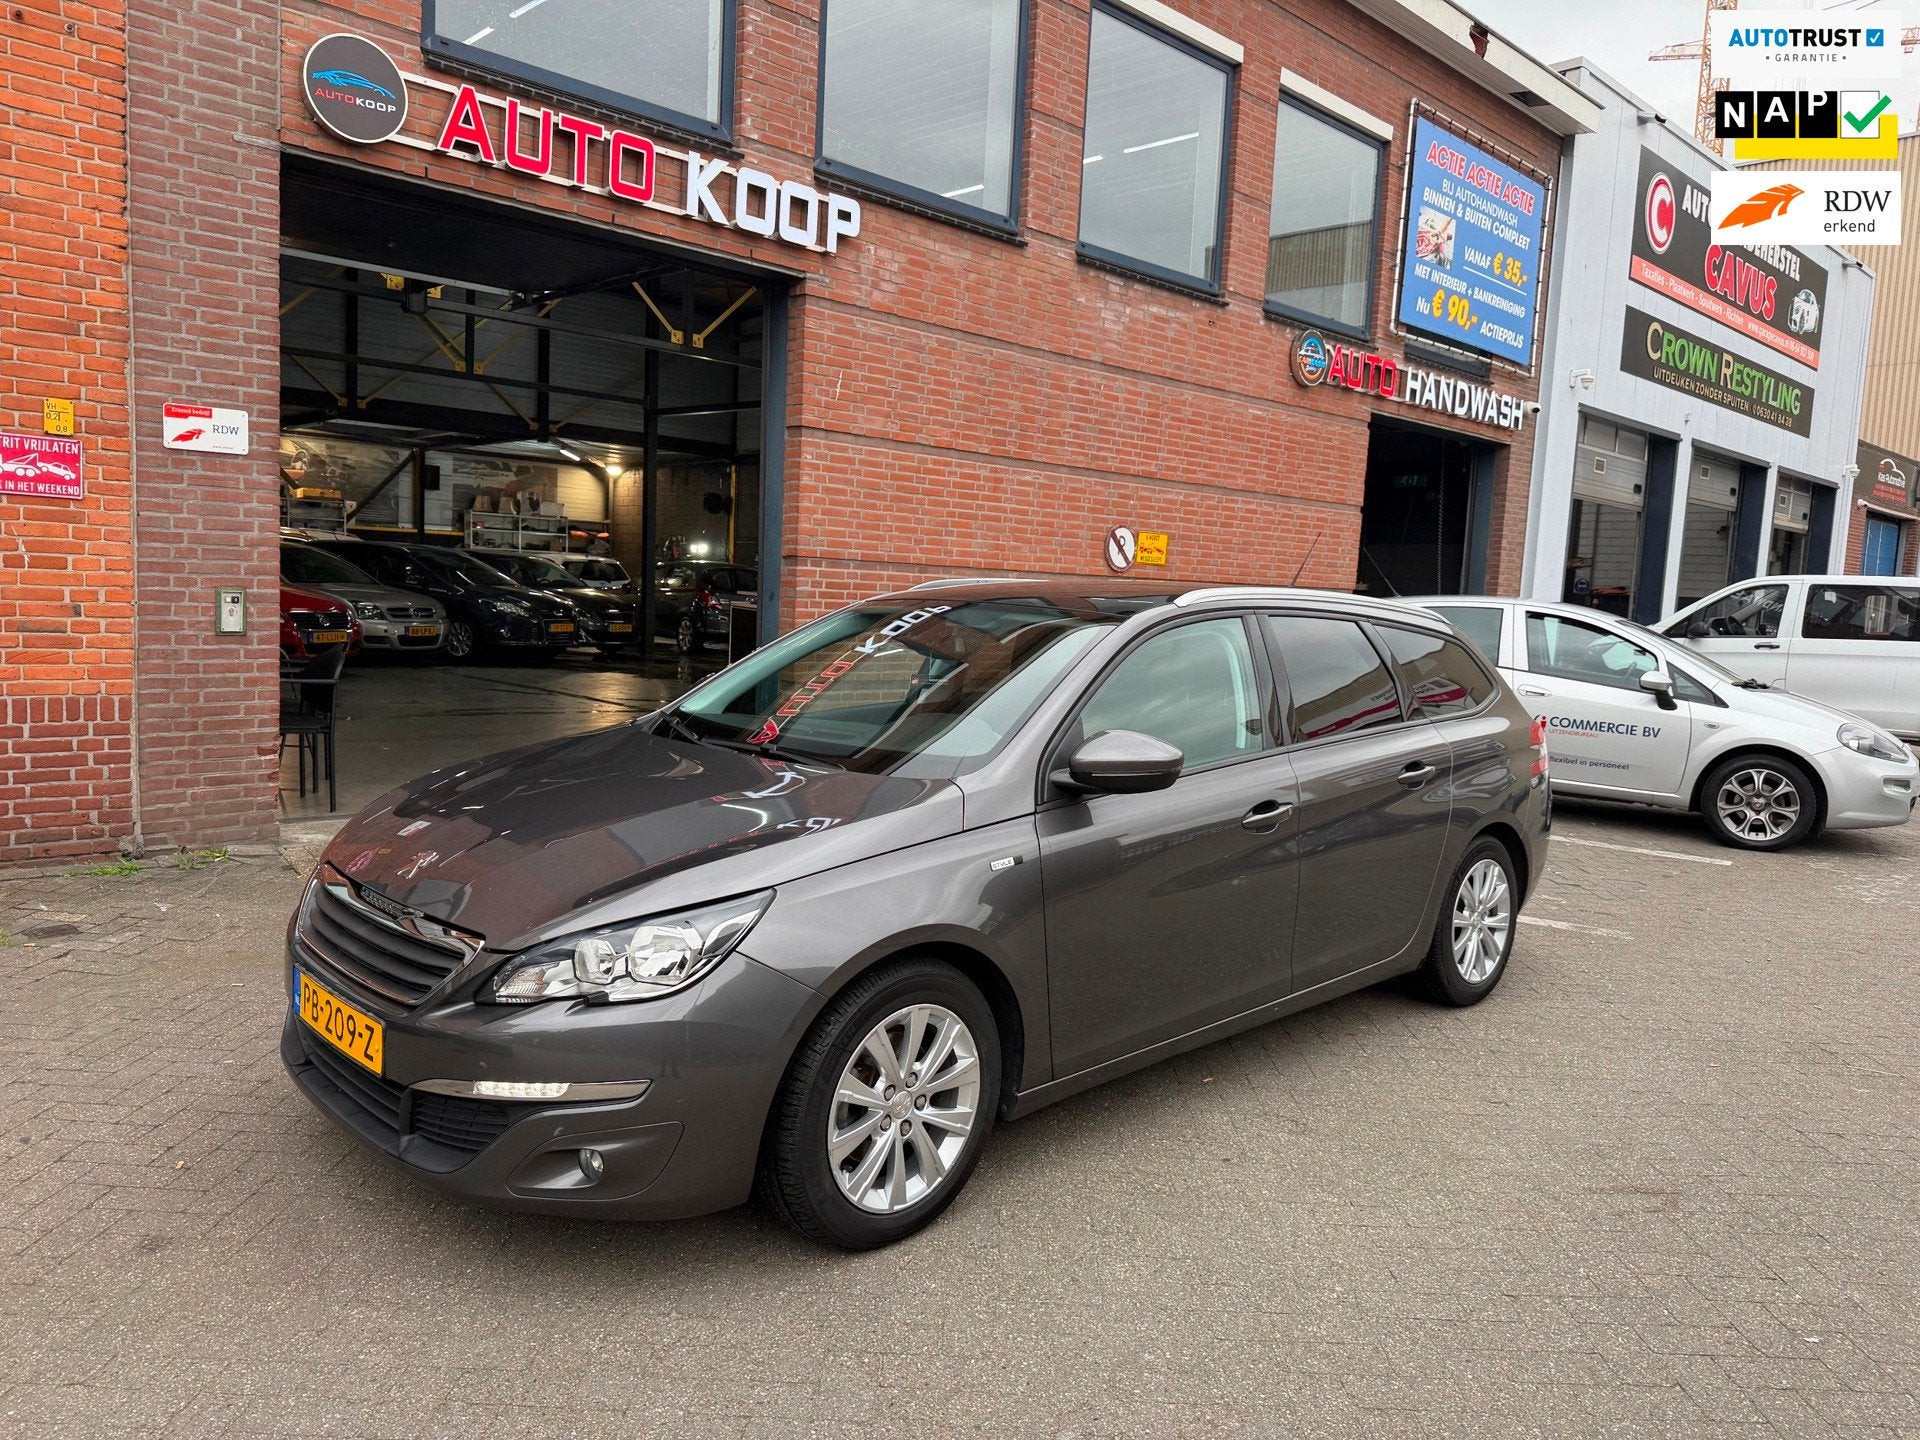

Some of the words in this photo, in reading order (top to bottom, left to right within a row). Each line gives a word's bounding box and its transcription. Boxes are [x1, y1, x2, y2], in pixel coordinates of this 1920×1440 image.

[315, 88, 396, 113] AUTOKOOP
[437, 85, 655, 202] AUTO
[686, 150, 861, 254] KOOP
[1427, 141, 1466, 179] ACTIE
[1466, 160, 1502, 198] ACTIE
[1501, 179, 1535, 216] ACTIE
[1423, 187, 1455, 213] BINNEN
[1457, 203, 1464, 218] &
[1464, 209, 1492, 232] BUITEN
[1492, 222, 1531, 251] COMPLEET
[1443, 178, 1455, 194] BIJ
[1455, 184, 1518, 228] AUTOHANDWASH
[1464, 246, 1492, 269] VANAF
[1493, 252, 1504, 275] €
[1704, 244, 1778, 321] CAVUS
[1415, 263, 1431, 280] MET
[1431, 269, 1467, 296] INTERIEUR
[1473, 287, 1526, 319] BANKREINIGING
[1416, 296, 1430, 316] Nu
[1432, 289, 1446, 319] €
[1480, 320, 1524, 349] ACTIEPRIJS
[1327, 344, 1397, 398] AUTO
[1404, 366, 1524, 431] HANDWASH
[1646, 322, 1719, 383] CROWN
[1720, 351, 1802, 416] RESTYLING
[1653, 366, 1695, 391] UITDEUKEN
[1695, 382, 1723, 402] ZONDER
[1723, 393, 1750, 412] SPUITEN
[212, 424, 240, 436] RDW
[5, 480, 15, 491] IN
[17, 481, 36, 493] HET
[37, 483, 80, 496] WEEKEND
[1549, 716, 1638, 736] COMMERCIE
[1642, 726, 1661, 738] BV
[1588, 759, 1630, 770] personeel
[302, 983, 375, 1062] PB-209-Z
